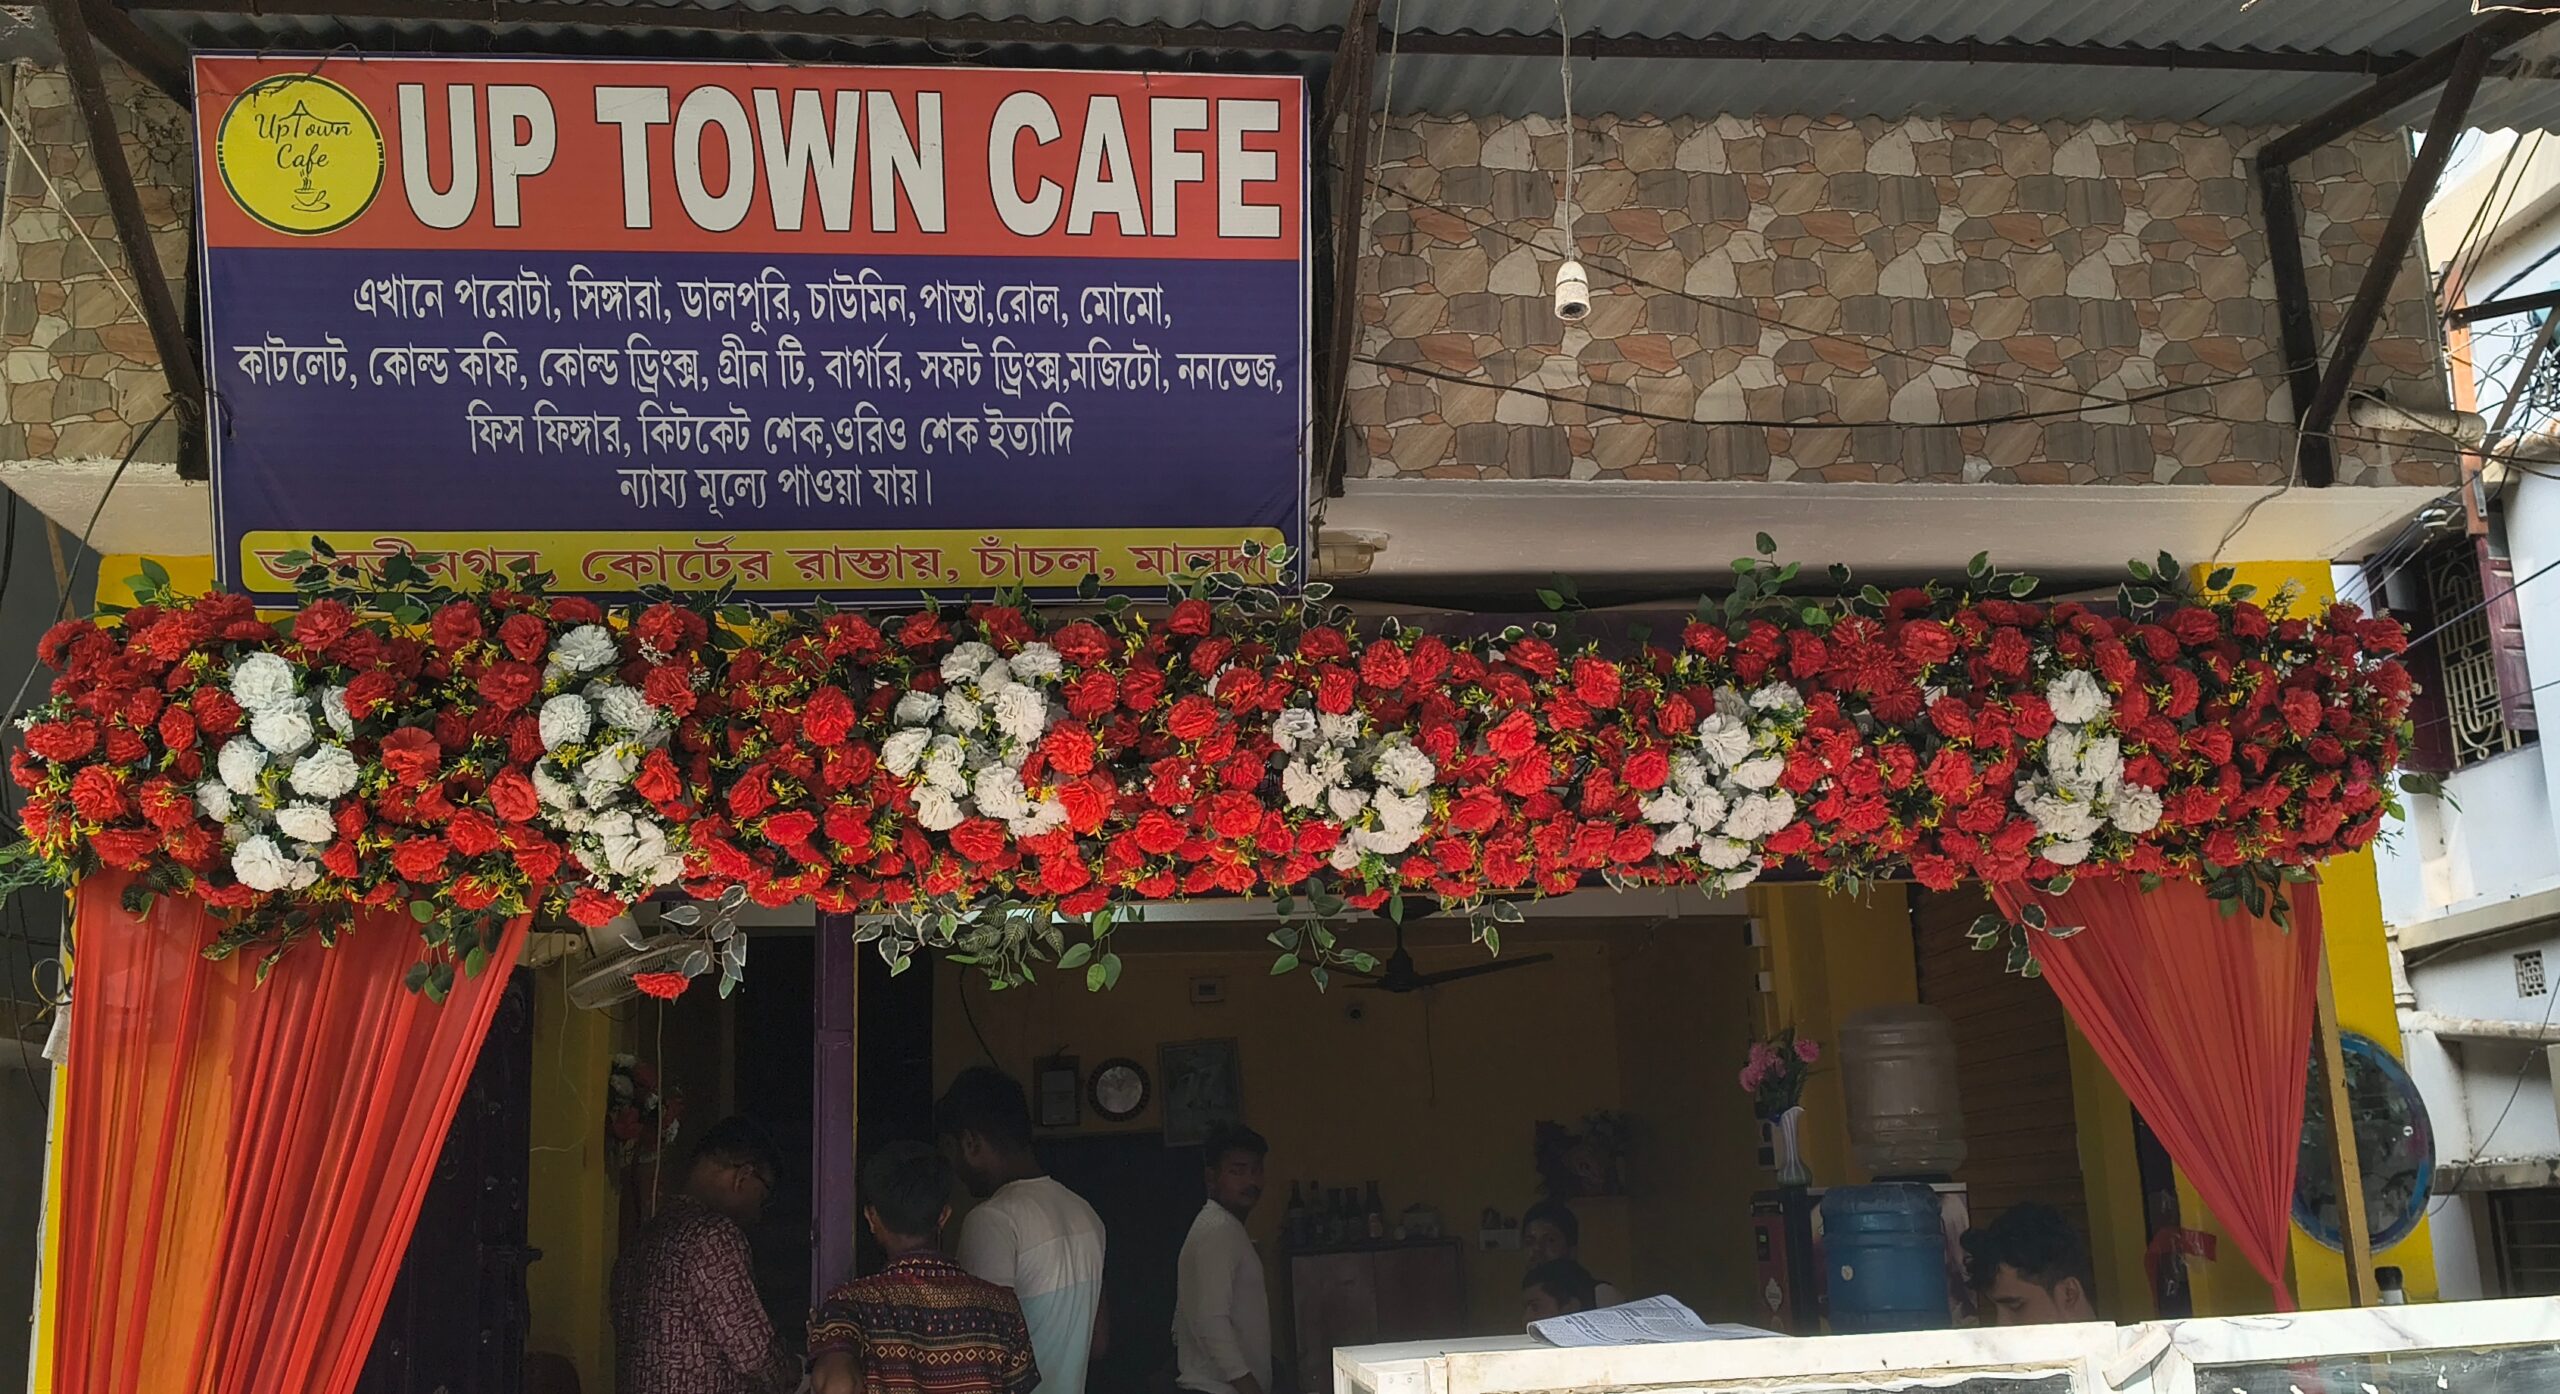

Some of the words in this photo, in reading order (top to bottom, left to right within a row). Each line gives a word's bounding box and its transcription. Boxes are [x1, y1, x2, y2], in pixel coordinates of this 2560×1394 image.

[277, 143, 329, 178] Cafe
[397, 83, 557, 230] UP
[594, 85, 947, 233] TOWN
[988, 90, 1281, 239] CAFE
[352, 272, 445, 320] এখানে
[453, 263, 562, 324] পরোটা,
[565, 263, 673, 326] সিঙ্গারা,
[675, 265, 801, 338] ডালপুরি,
[804, 266, 917, 328] চাউমিন,
[1079, 280, 1173, 330] মোমো,
[231, 329, 359, 391] কাটলেট,
[368, 340, 451, 388] কোল্ড
[452, 330, 529, 392] কফি,
[538, 342, 621, 389] কোল্ড
[716, 332, 770, 390] গ্রীন
[774, 332, 816, 394] টি,
[819, 331, 913, 394] বার্গার,
[917, 335, 985, 390] সফট
[1174, 352, 1284, 395] ননভেজ,
[464, 397, 526, 455] ফিস
[530, 398, 632, 459] ফিঙ্গার,
[635, 398, 753, 456] কিটকেট
[919, 411, 981, 456] শেক
[981, 400, 1076, 460] ইত্যাদি
[615, 462, 689, 510] ন্যায্য
[693, 468, 769, 520] মূল্যে
[776, 463, 863, 507] পাওয়া
[581, 535, 774, 583] কোর্টের
[784, 544, 959, 584] রাস্তায়,
[971, 535, 1117, 582] চাঁচল,
